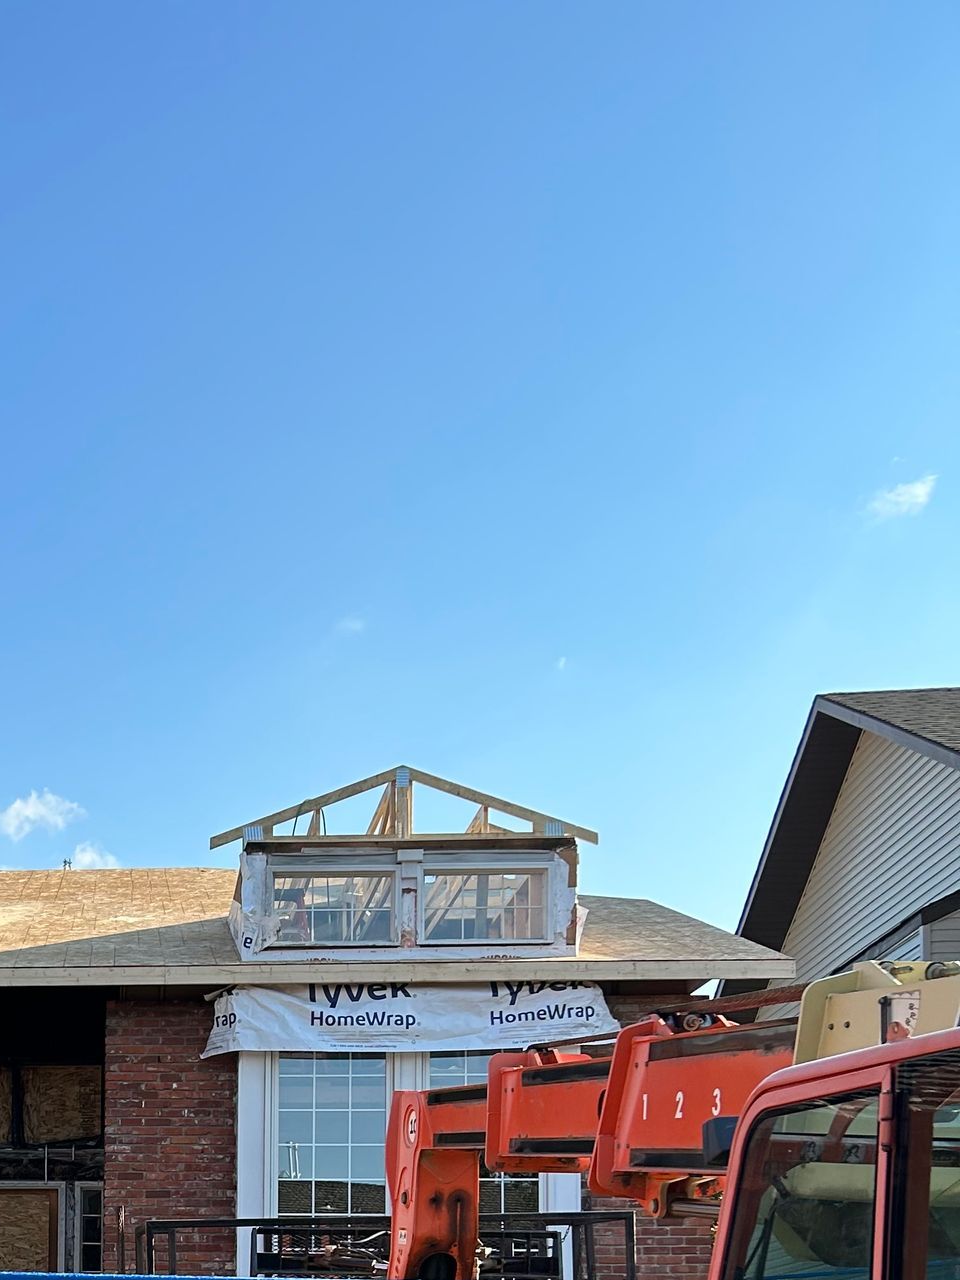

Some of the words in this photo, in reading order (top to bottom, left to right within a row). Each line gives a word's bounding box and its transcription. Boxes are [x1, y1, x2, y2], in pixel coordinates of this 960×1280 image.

[310, 1010, 416, 1029] HomeWrap
[490, 1004, 595, 1025] HomeWrap
[642, 1093, 649, 1121] 1
[674, 1091, 684, 1119] 2
[711, 1087, 721, 1116] 3
